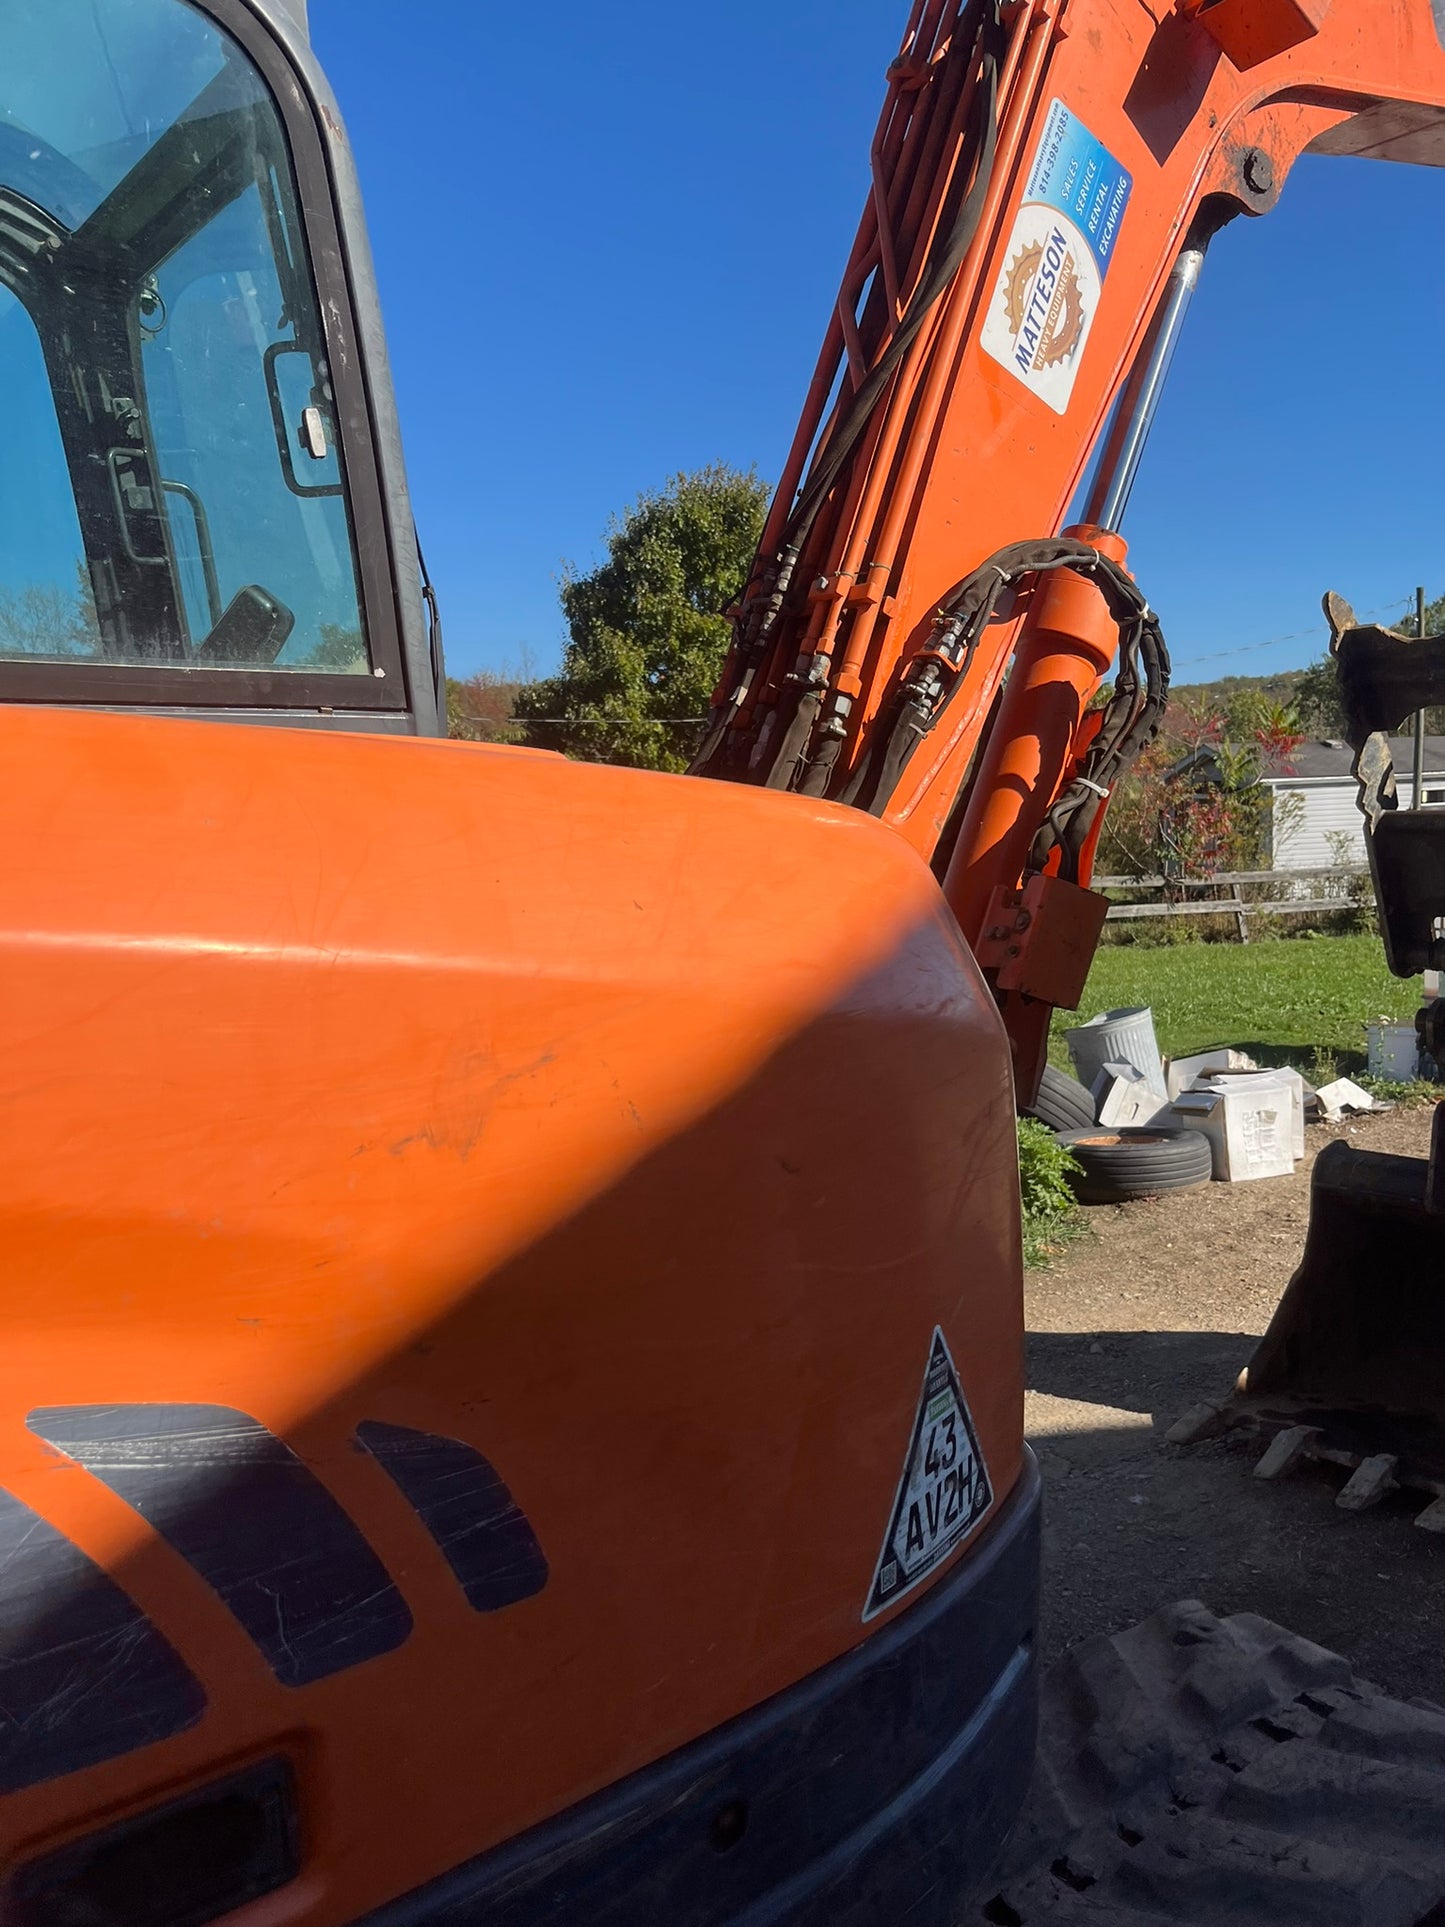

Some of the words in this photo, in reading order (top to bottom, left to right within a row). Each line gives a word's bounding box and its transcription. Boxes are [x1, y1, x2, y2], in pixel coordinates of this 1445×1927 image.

[1038, 110, 1069, 194] 814-398-2085
[1061, 158, 1079, 200] SALES
[1075, 159, 1096, 216] SERVICE
[1088, 183, 1108, 233] RENTAL
[1099, 176, 1127, 256] EXCAVATING
[1015, 226, 1067, 374] MATTESON
[1036, 332, 1052, 368] HEAVY
[1048, 261, 1072, 326] EQUIPMENT
[924, 1411, 957, 1479] 43
